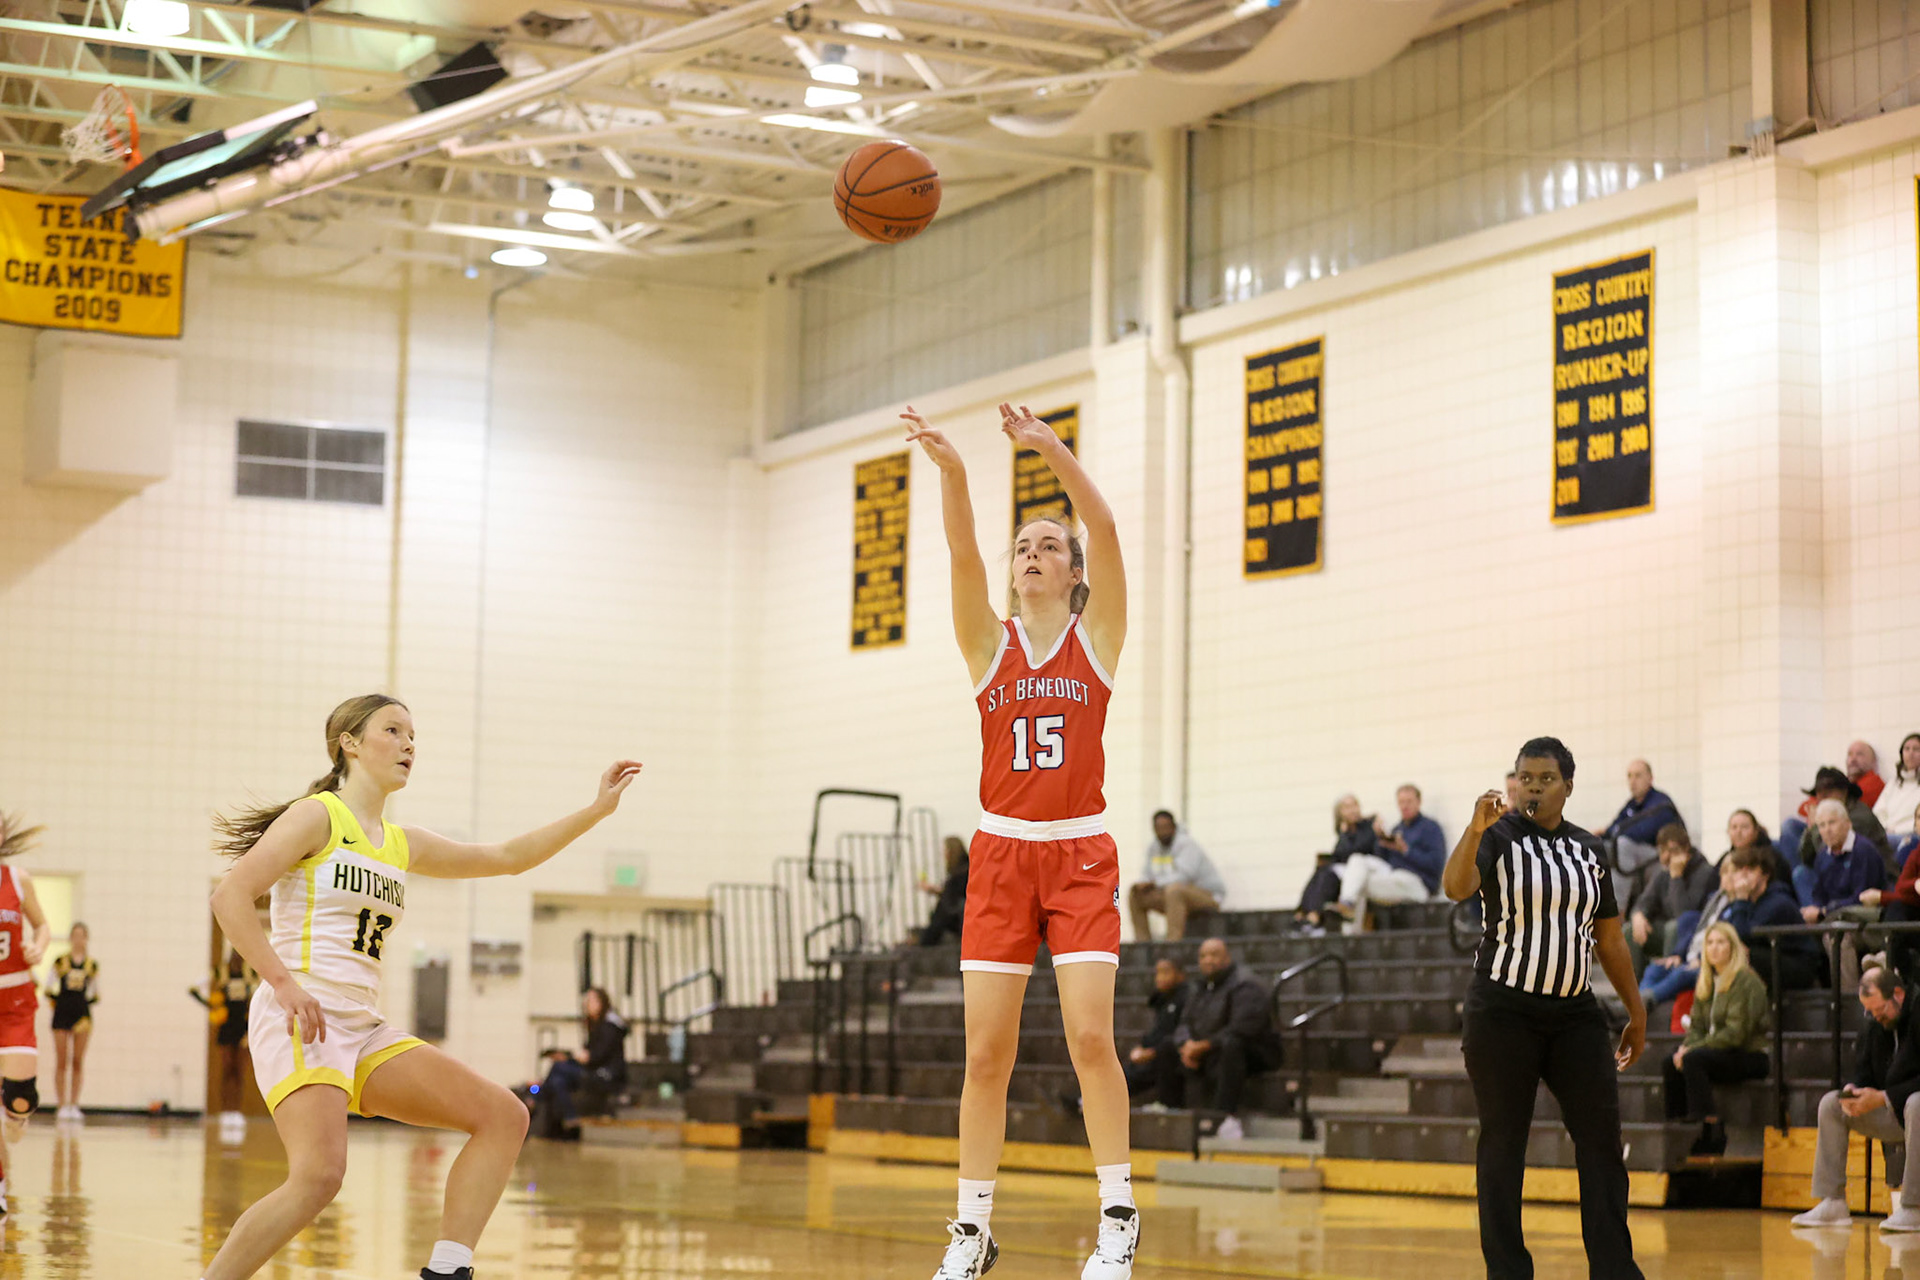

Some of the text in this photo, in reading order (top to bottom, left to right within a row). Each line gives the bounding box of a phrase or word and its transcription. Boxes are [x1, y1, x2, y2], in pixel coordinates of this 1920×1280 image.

[45, 233, 137, 265] STATE
[5, 258, 173, 298] CHAMPIONS
[54, 294, 122, 323] 2009
[1562, 308, 1645, 352] REGION
[1555, 346, 1648, 391] RUNNER-UP
[988, 676, 1090, 713] ST. BENEDICT
[1011, 713, 1066, 772] 15
